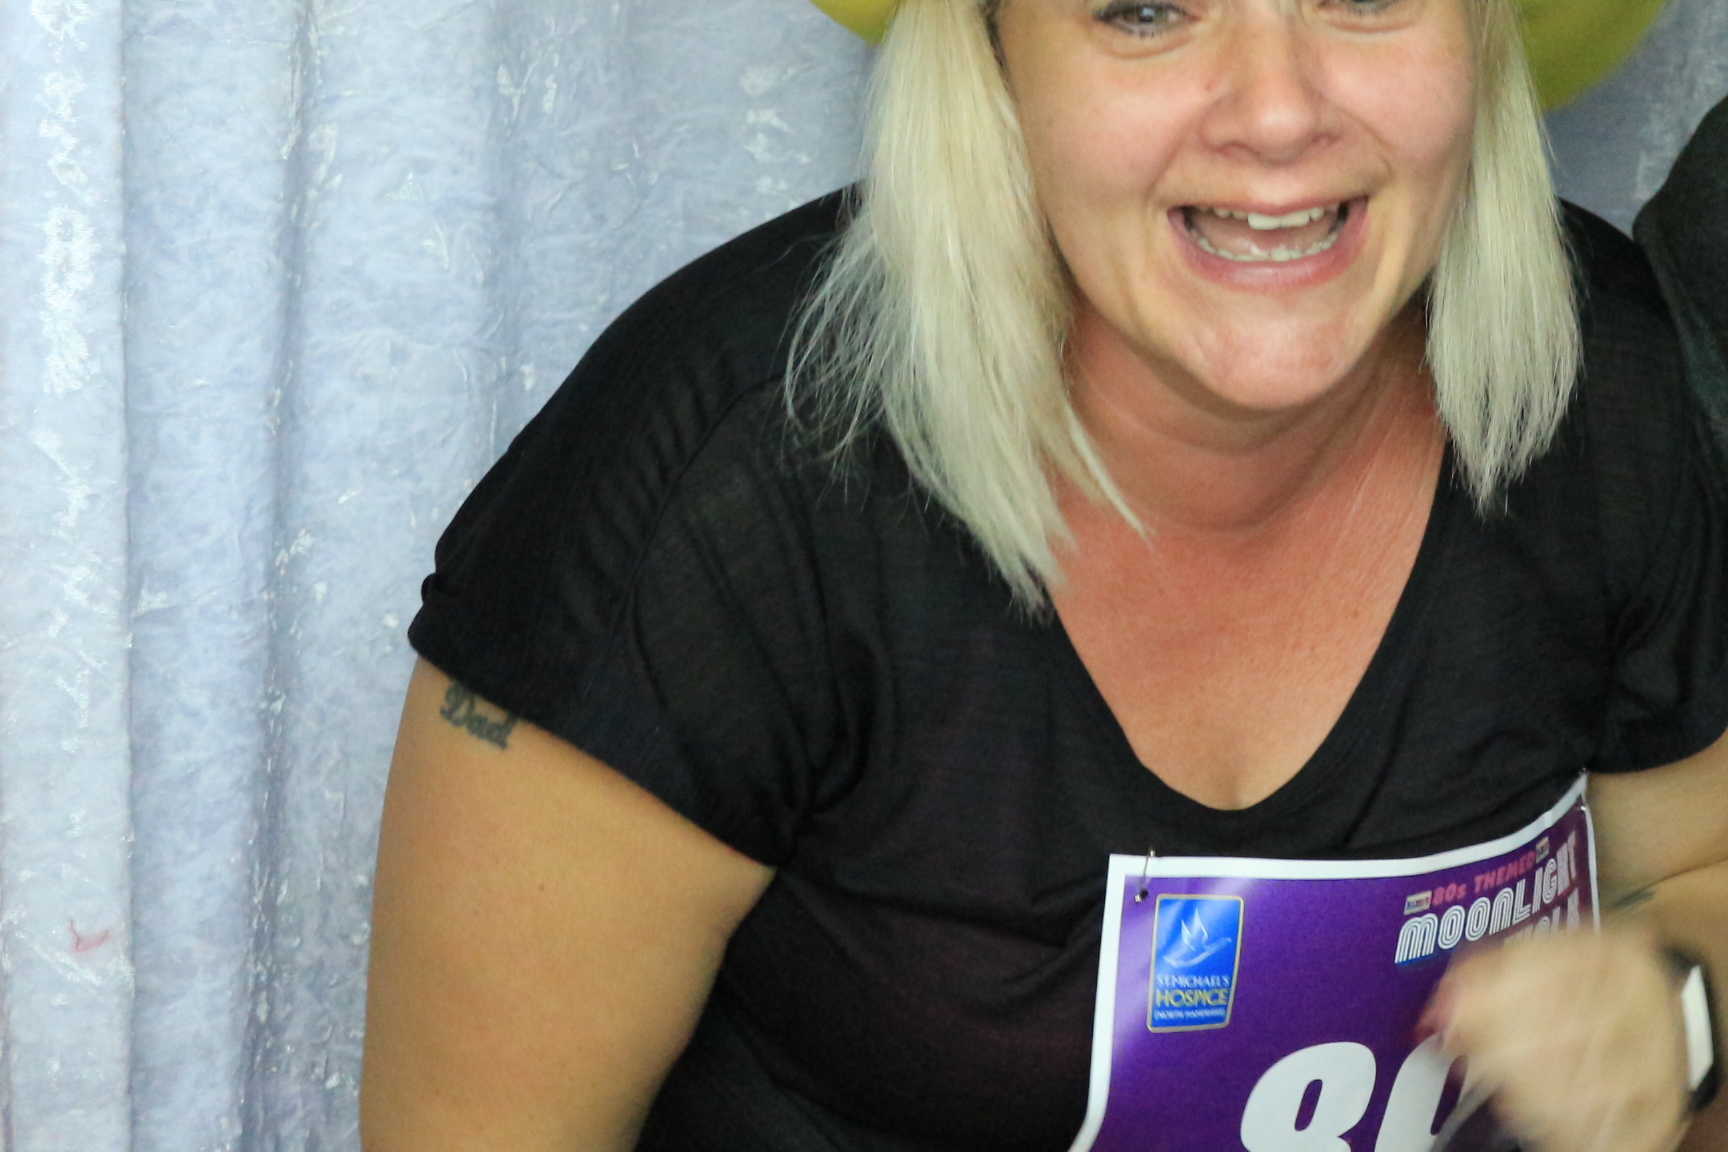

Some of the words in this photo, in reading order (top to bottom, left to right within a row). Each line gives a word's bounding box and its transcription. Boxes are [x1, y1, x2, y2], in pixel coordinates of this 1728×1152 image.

[1394, 831, 1577, 964] MOONLIGHT
[1432, 881, 1467, 906] 80s
[1473, 850, 1537, 894] THEMED
[1155, 988, 1229, 1008] HOSPICE
